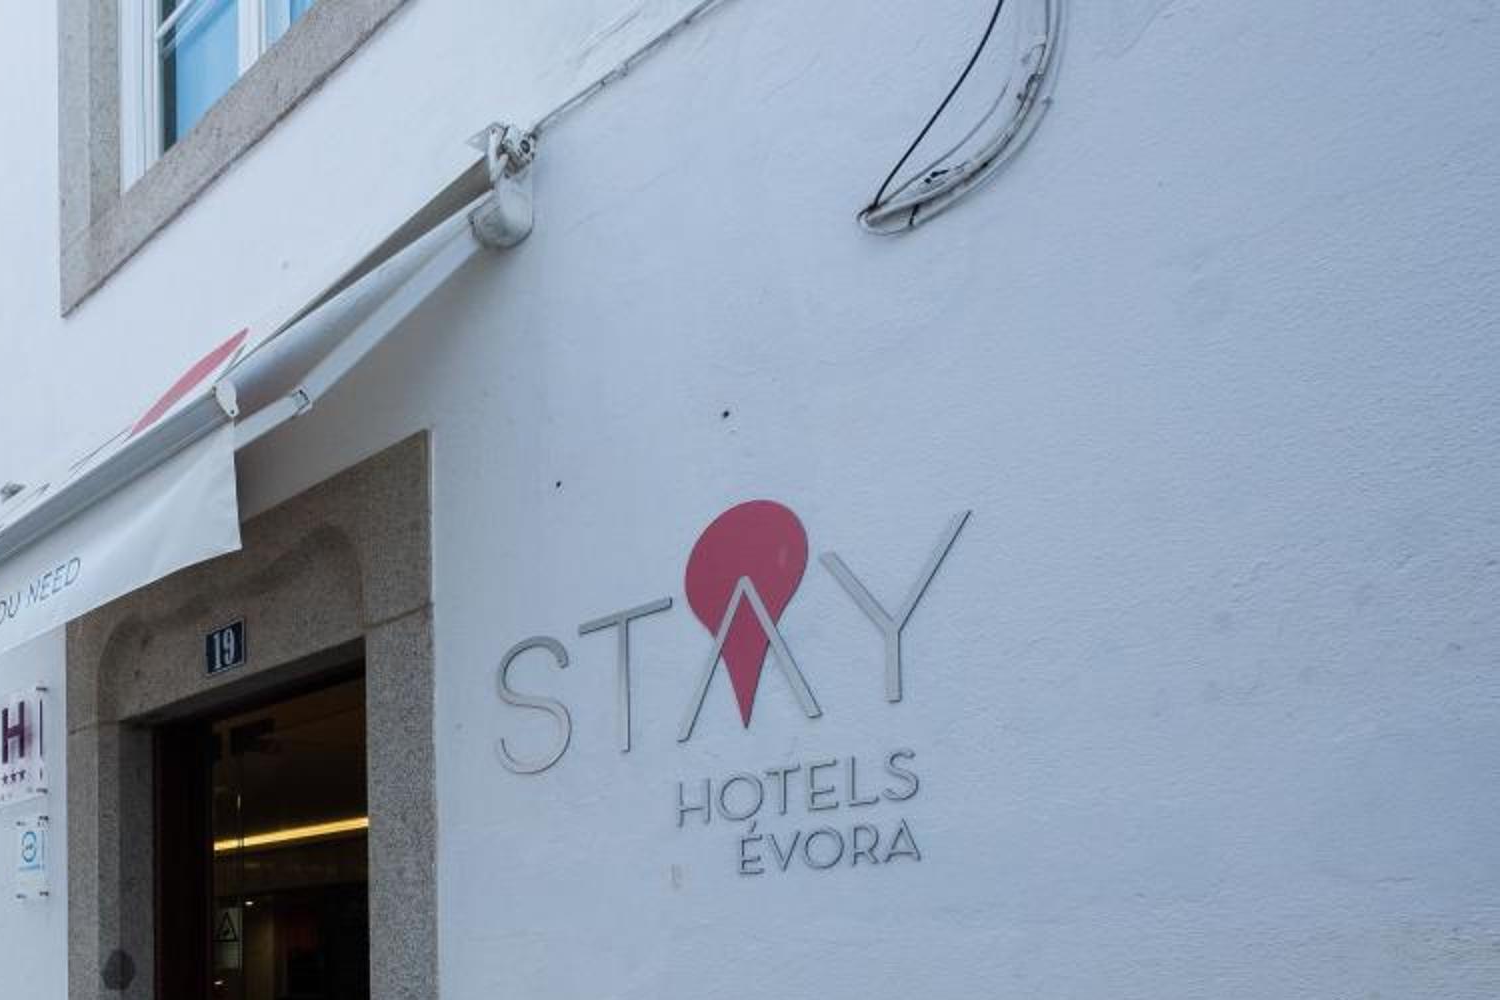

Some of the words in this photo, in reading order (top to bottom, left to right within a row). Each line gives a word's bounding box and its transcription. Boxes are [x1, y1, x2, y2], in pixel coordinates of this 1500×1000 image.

[28, 557, 81, 607] NEED
[213, 628, 234, 668] 19
[498, 508, 973, 776] STAY
[2, 700, 25, 763] H
[676, 749, 919, 828] HOTELS
[738, 819, 921, 875] ÉVORA
